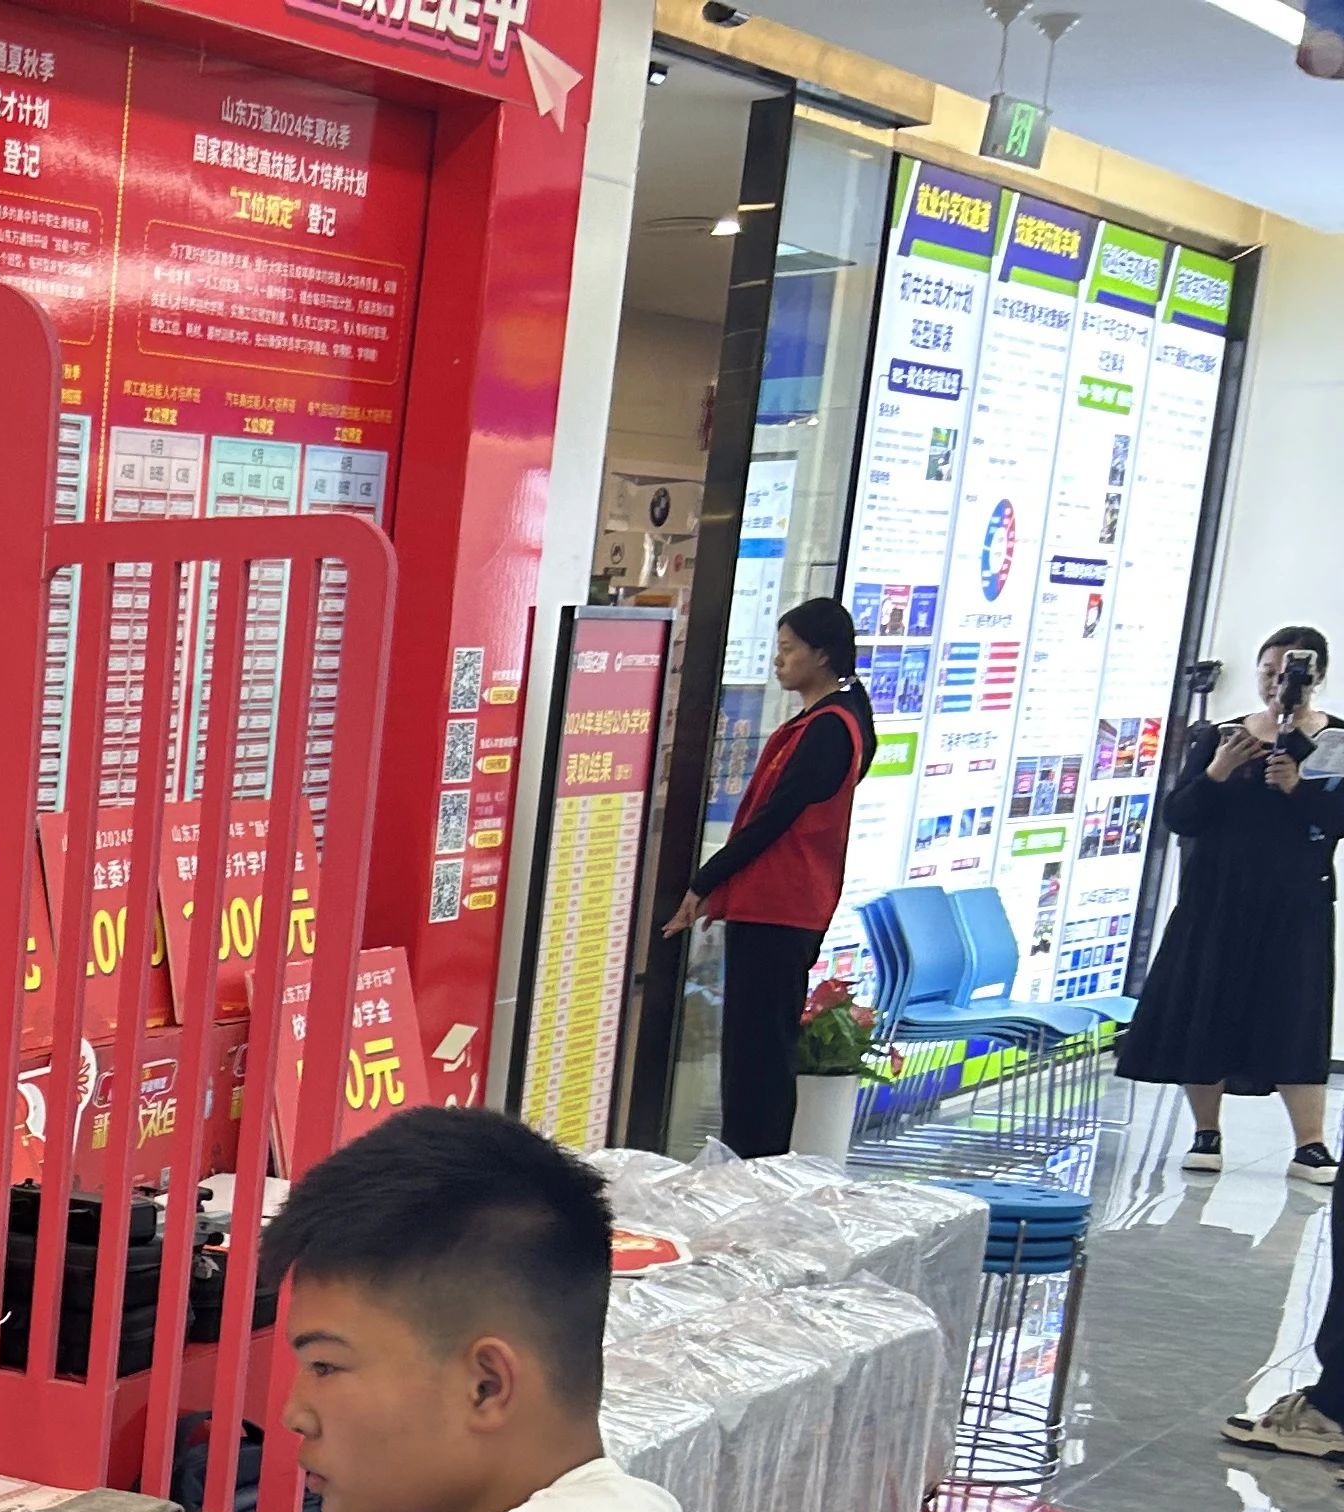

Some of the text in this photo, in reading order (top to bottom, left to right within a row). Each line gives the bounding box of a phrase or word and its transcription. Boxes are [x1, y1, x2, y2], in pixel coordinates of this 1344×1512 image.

[220, 95, 352, 151] 山东万通2024年夏秋季
[2, 139, 41, 179] 登记
[192, 133, 369, 198] 国家紧缺型高技能人才培养计划
[305, 203, 337, 238] 登记
